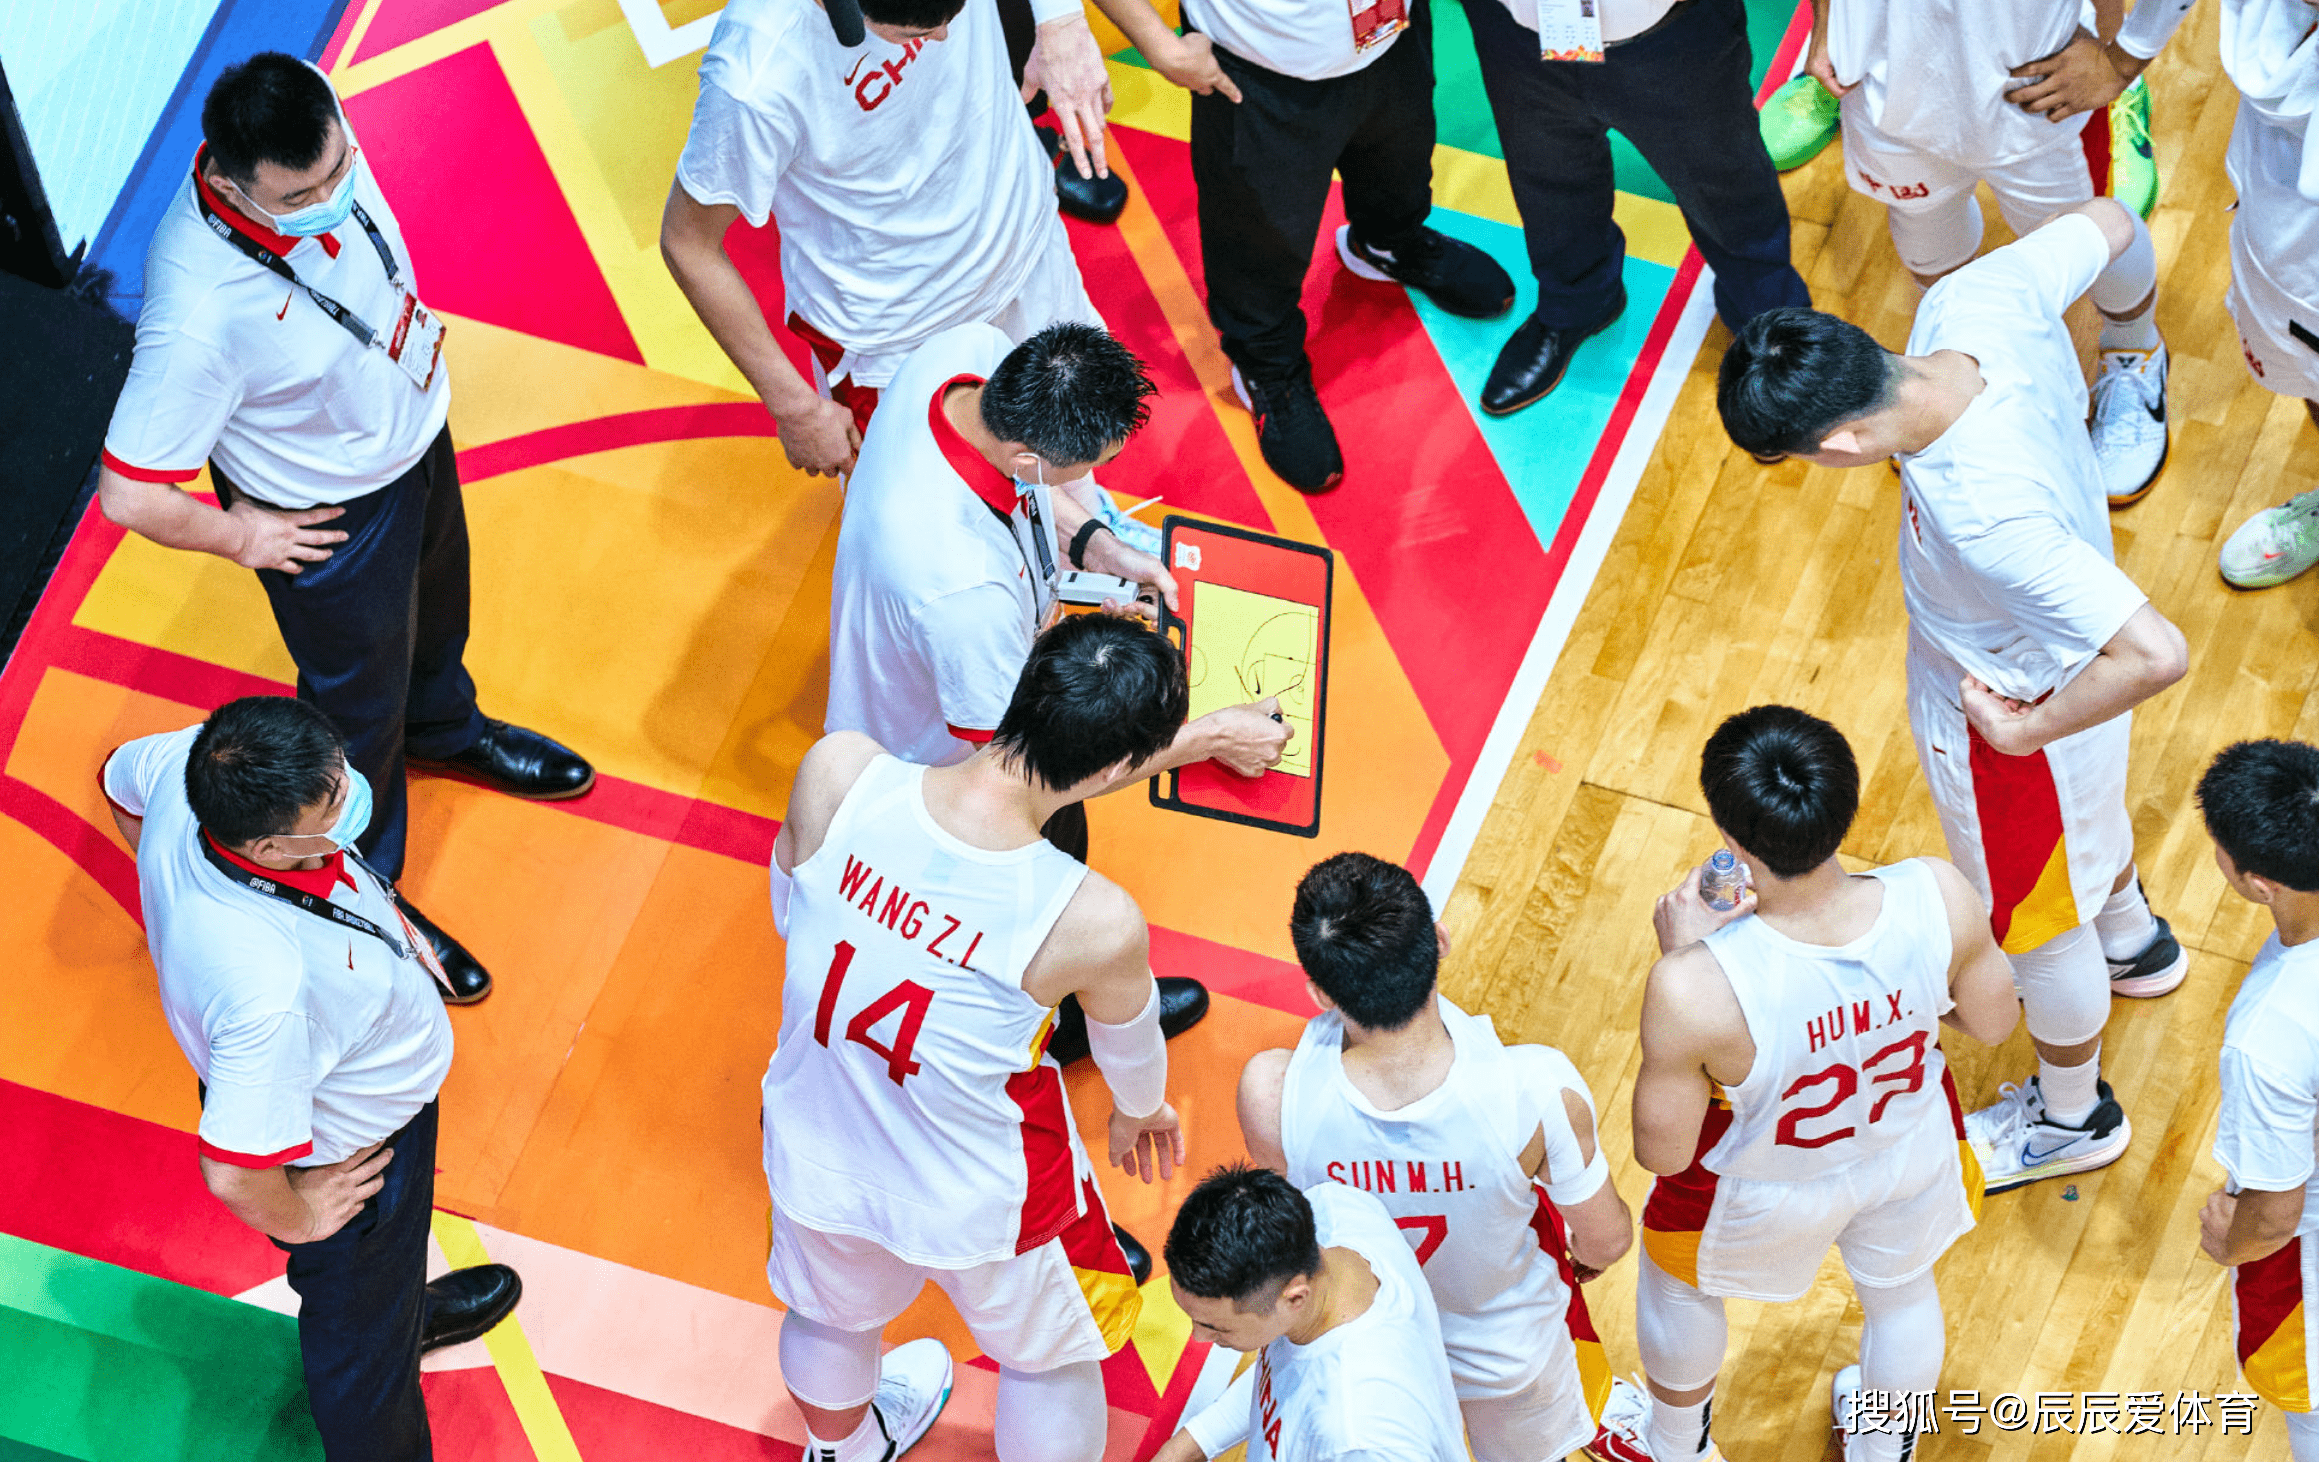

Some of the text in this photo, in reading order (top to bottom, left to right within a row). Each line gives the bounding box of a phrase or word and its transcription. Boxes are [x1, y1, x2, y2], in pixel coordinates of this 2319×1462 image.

[249, 876, 276, 895] @FIBA
[839, 854, 930, 940] WANG
[814, 939, 936, 1087] 14
[1807, 990, 1916, 1053] HU M.X.
[1775, 1030, 1929, 1149] 23
[1327, 1160, 1475, 1194] SUN M.H.
